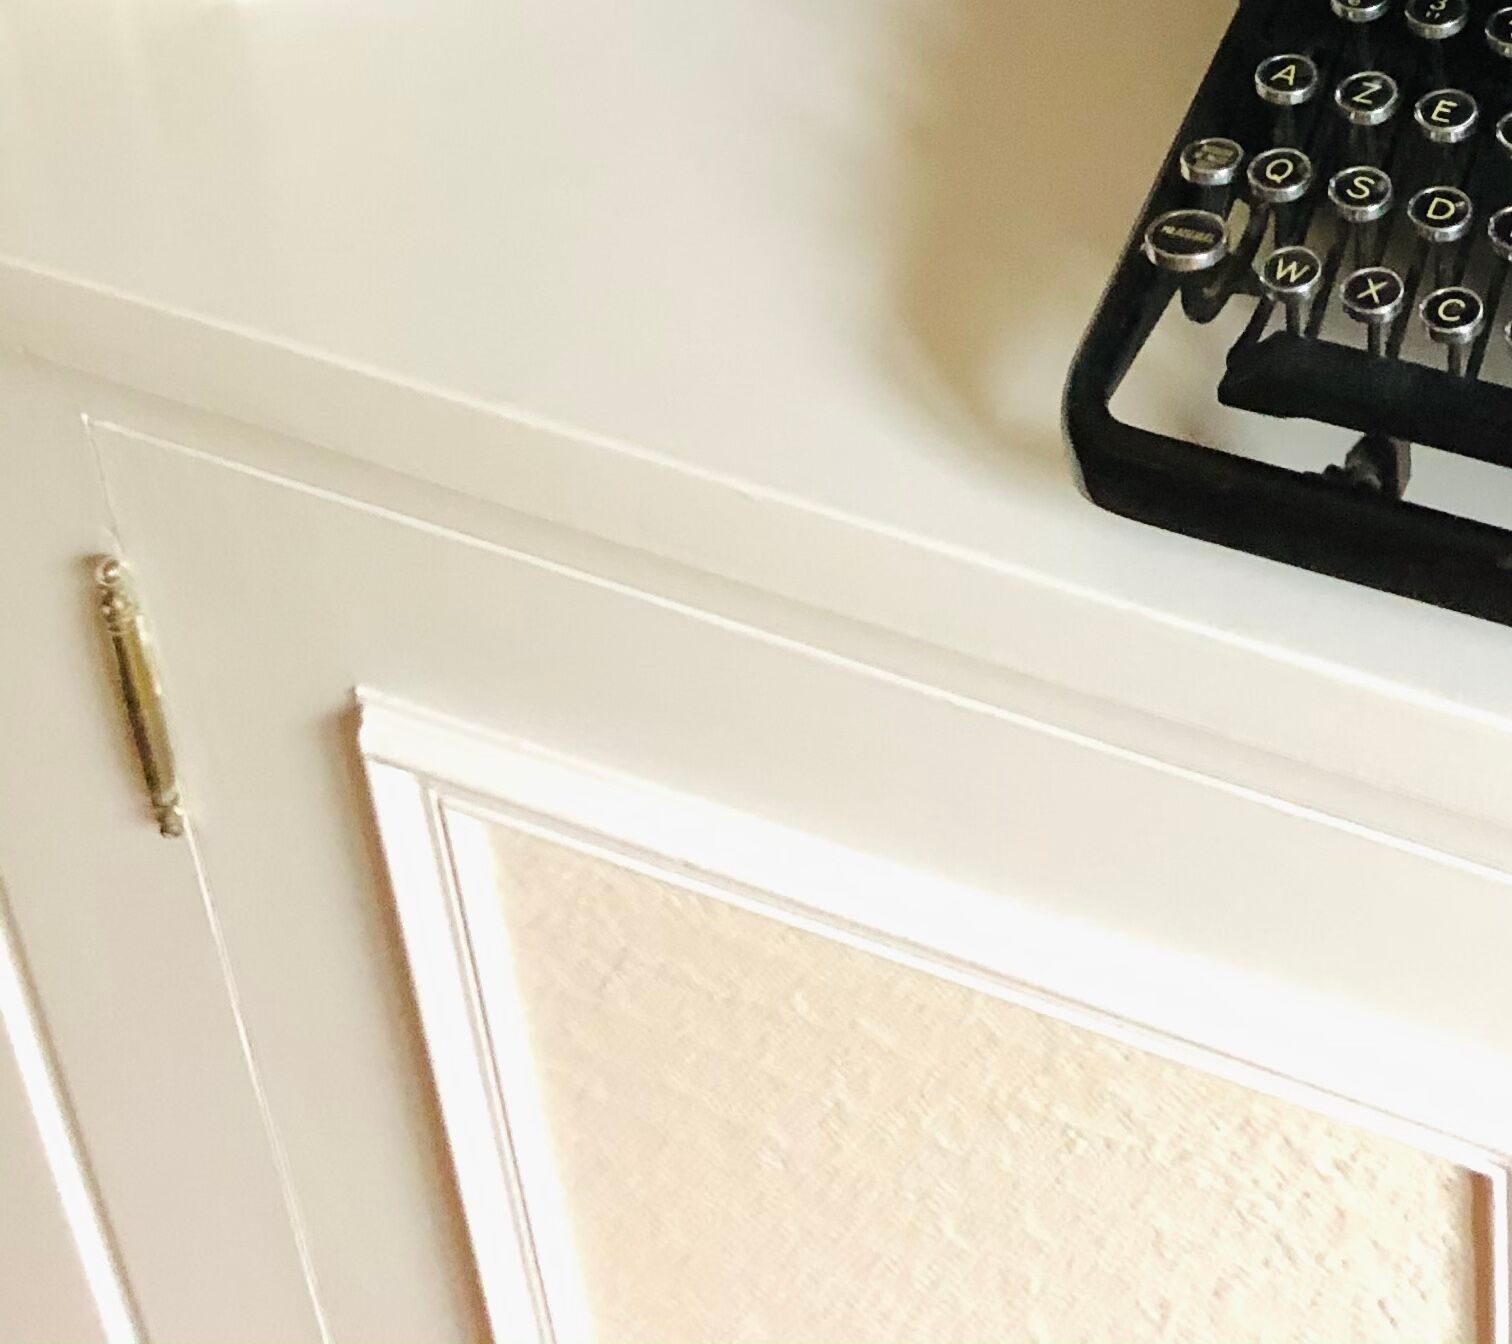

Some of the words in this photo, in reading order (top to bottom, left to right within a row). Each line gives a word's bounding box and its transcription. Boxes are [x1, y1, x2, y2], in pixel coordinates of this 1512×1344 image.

[1270, 64, 1296, 86] A
[1351, 79, 1383, 105] Z
[1430, 99, 1458, 123] E
[1265, 158, 1294, 184] Q
[1345, 175, 1373, 200] S
[1426, 196, 1454, 220] D
[1273, 257, 1308, 283] W
[1356, 277, 1389, 305] X
[1437, 298, 1466, 322] C
